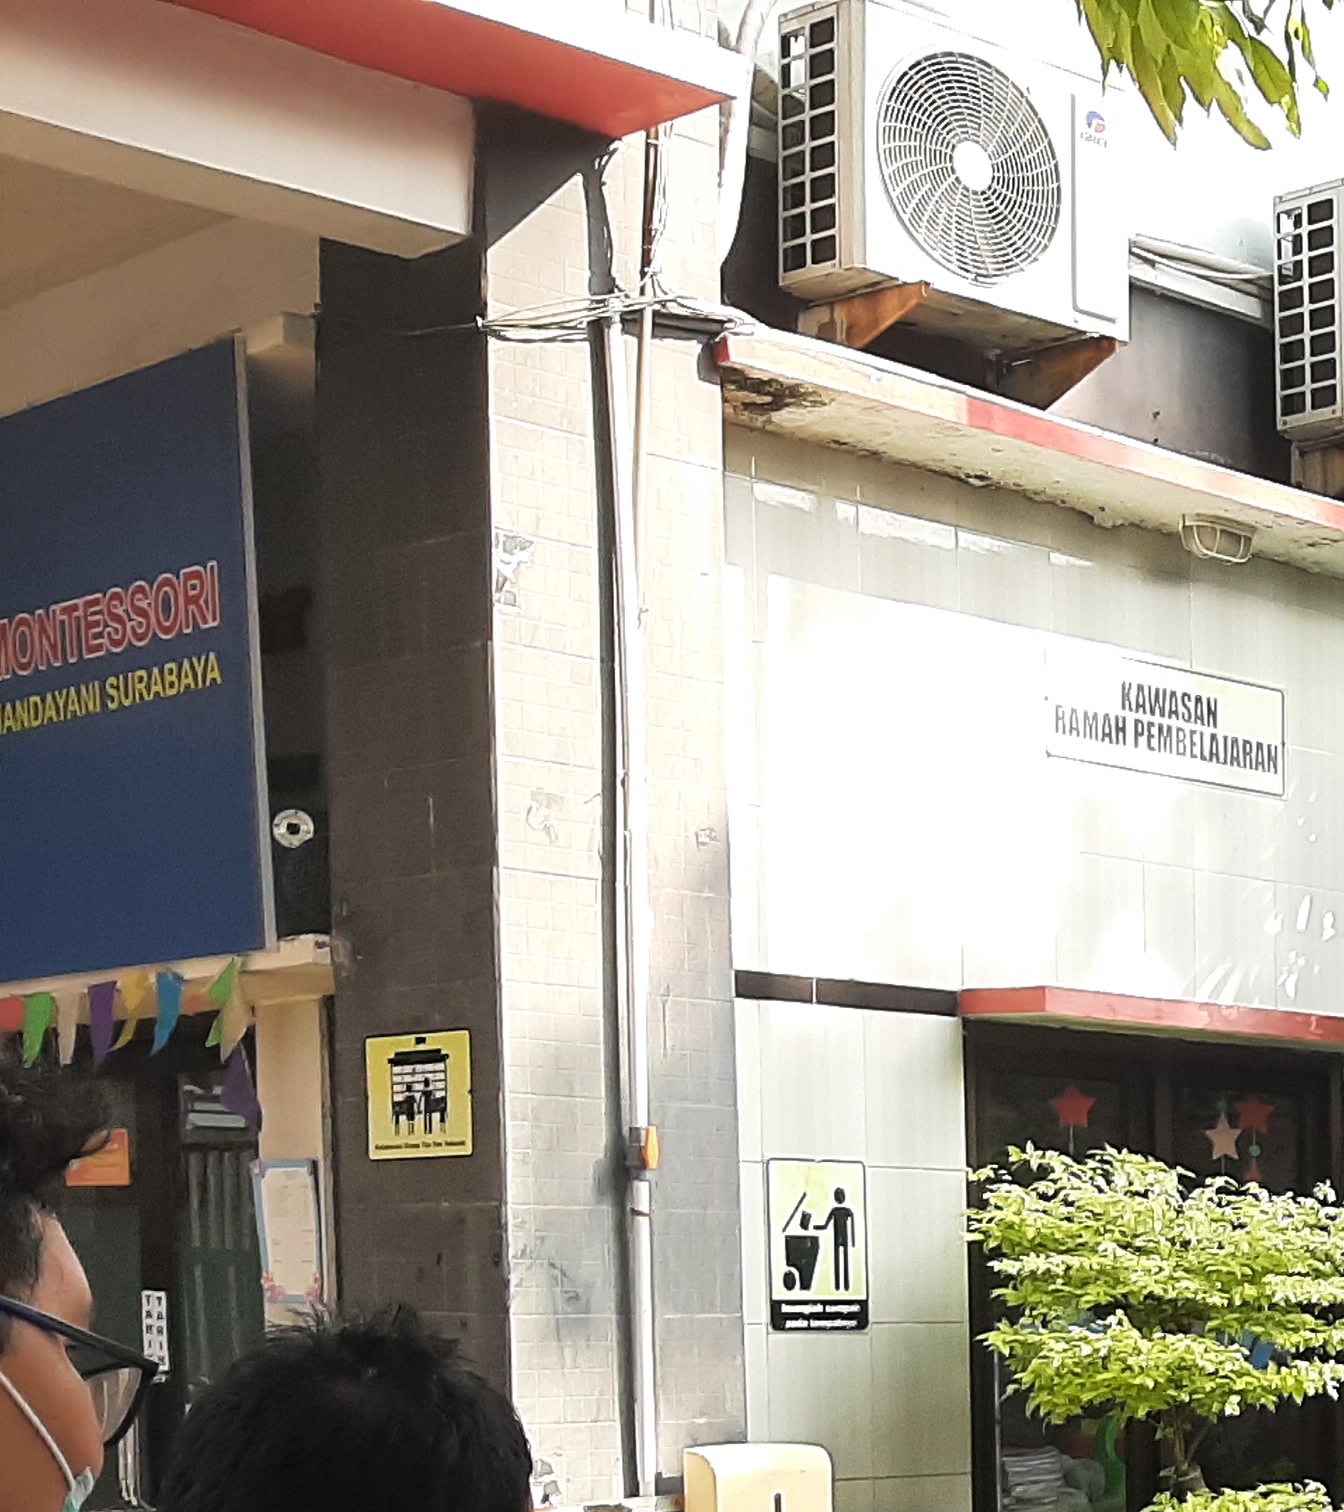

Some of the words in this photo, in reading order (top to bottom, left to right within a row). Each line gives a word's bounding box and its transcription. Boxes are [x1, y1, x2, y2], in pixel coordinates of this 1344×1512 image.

[105, 651, 223, 711] SURABAYA
[1121, 680, 1218, 729] KAWASAN
[1055, 704, 1127, 746] RAMAH
[1133, 718, 1279, 775] PEMBELAJARAN
